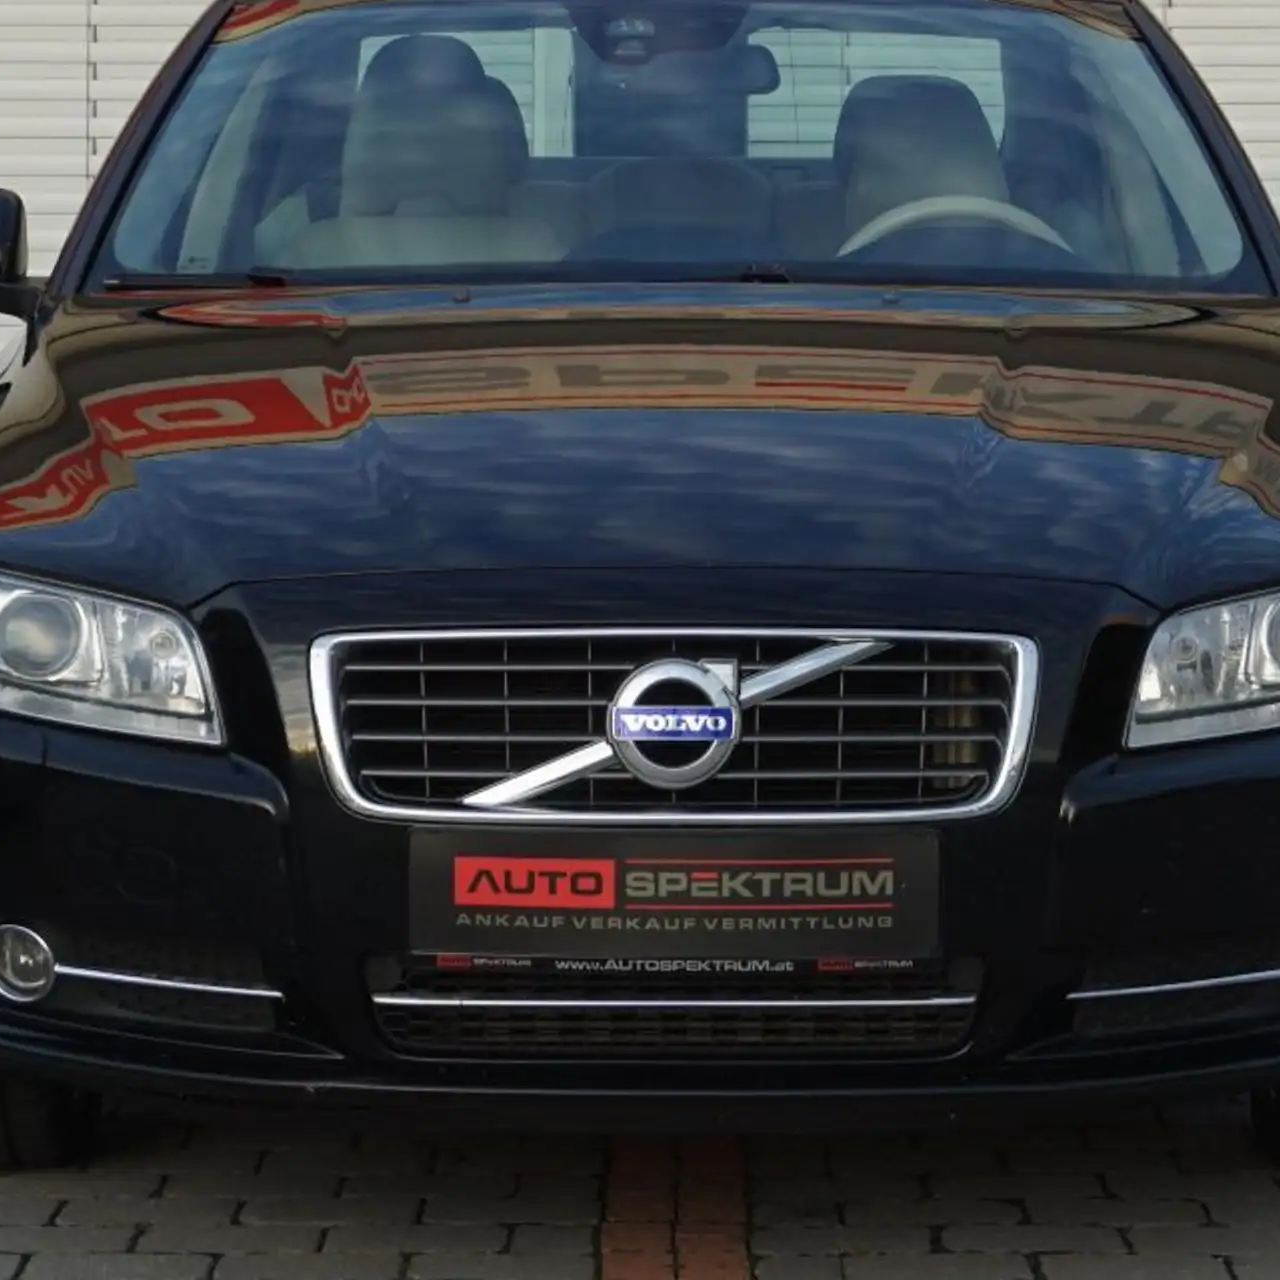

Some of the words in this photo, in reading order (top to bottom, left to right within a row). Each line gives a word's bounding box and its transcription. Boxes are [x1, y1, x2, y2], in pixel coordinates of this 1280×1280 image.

[620, 714, 727, 732] VOLVO
[467, 870, 603, 895] AUTO
[625, 871, 894, 897] SPEKTRUM
[456, 913, 565, 928] ANKAUF
[572, 916, 696, 930] VERKAUF
[705, 916, 893, 930] VERMITTLUNG
[554, 959, 795, 972] www.AUTOSPEKTRUM.at
